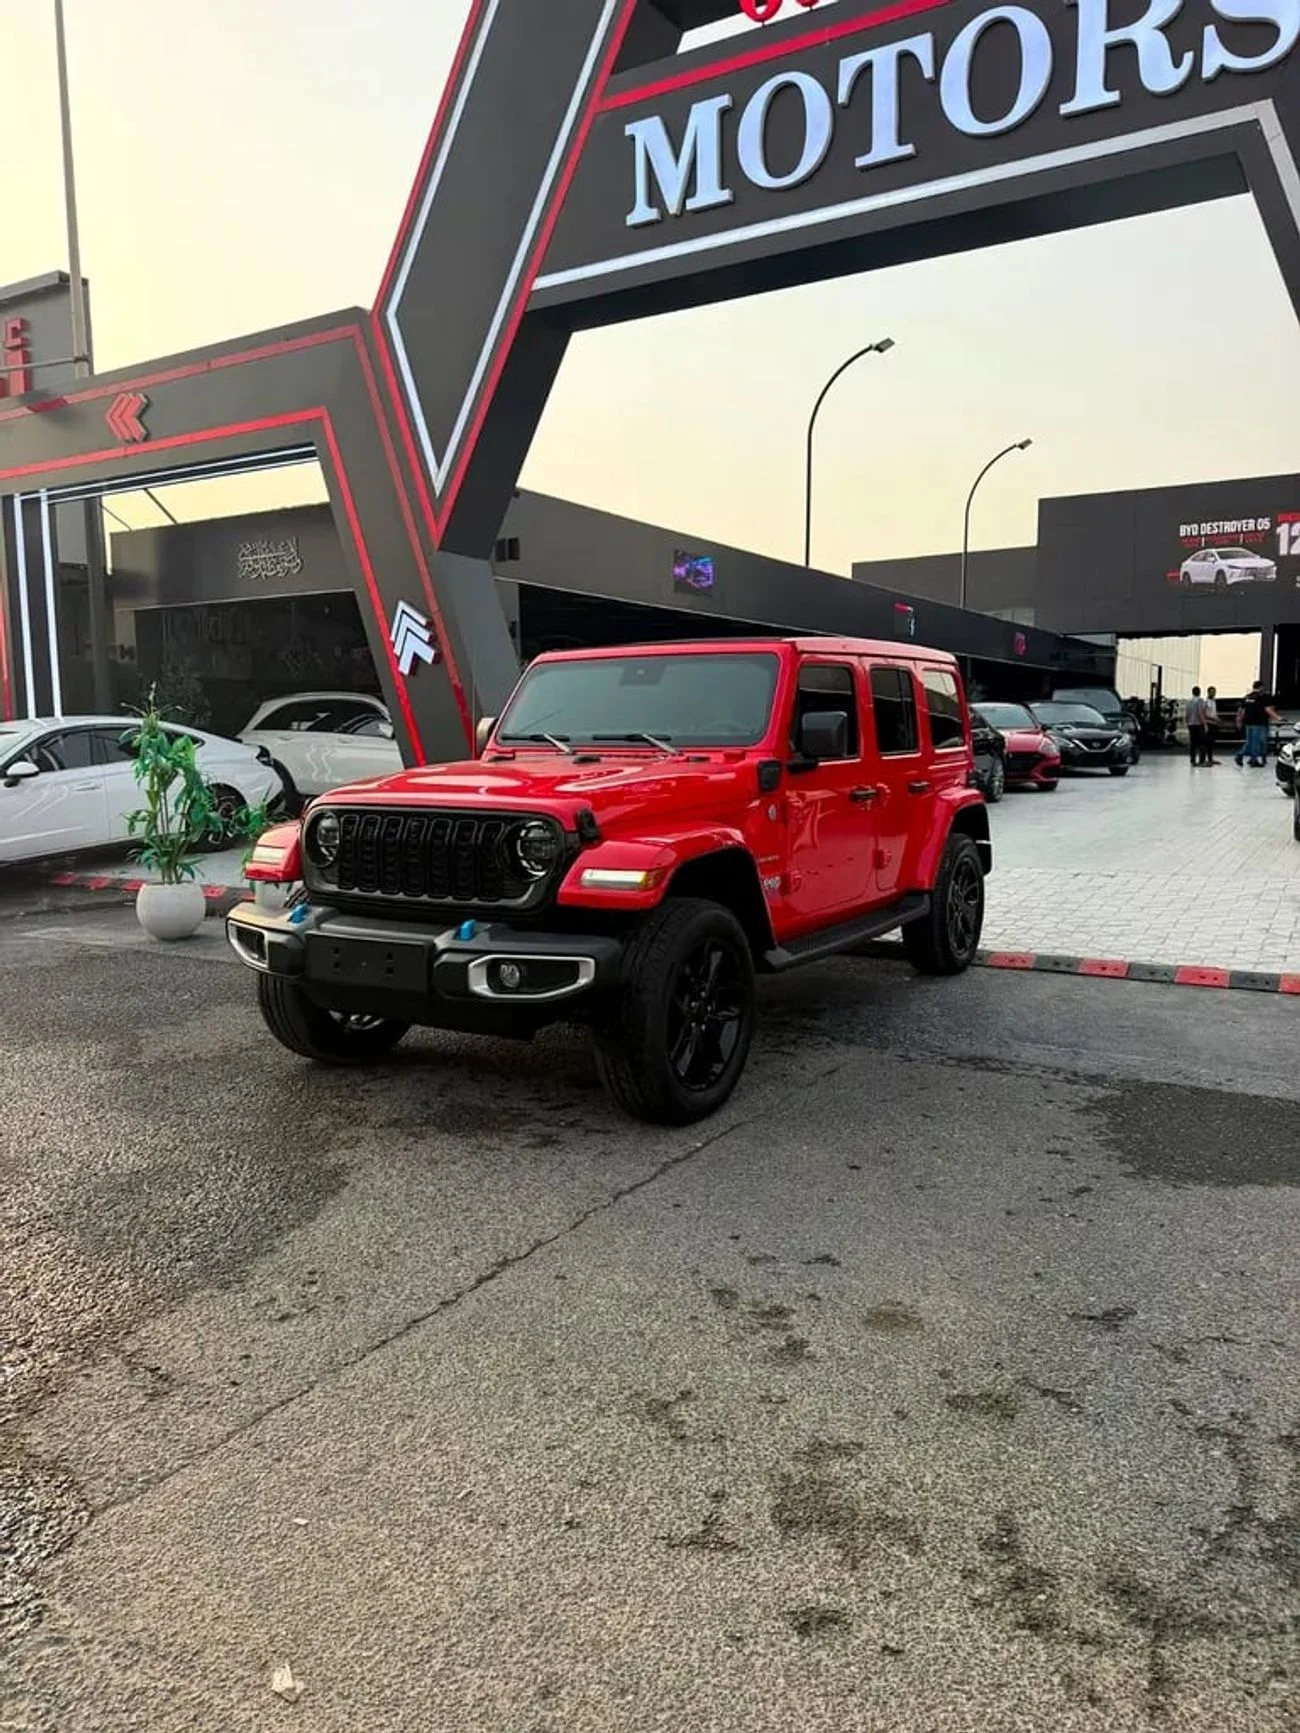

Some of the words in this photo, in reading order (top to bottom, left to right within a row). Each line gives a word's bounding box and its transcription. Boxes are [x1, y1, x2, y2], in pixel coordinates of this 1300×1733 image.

[625, 0, 1300, 227] MOTORS
[1179, 524, 1198, 537] BYD
[1200, 519, 1255, 535] DESTROYER
[1257, 517, 1271, 531] 05
